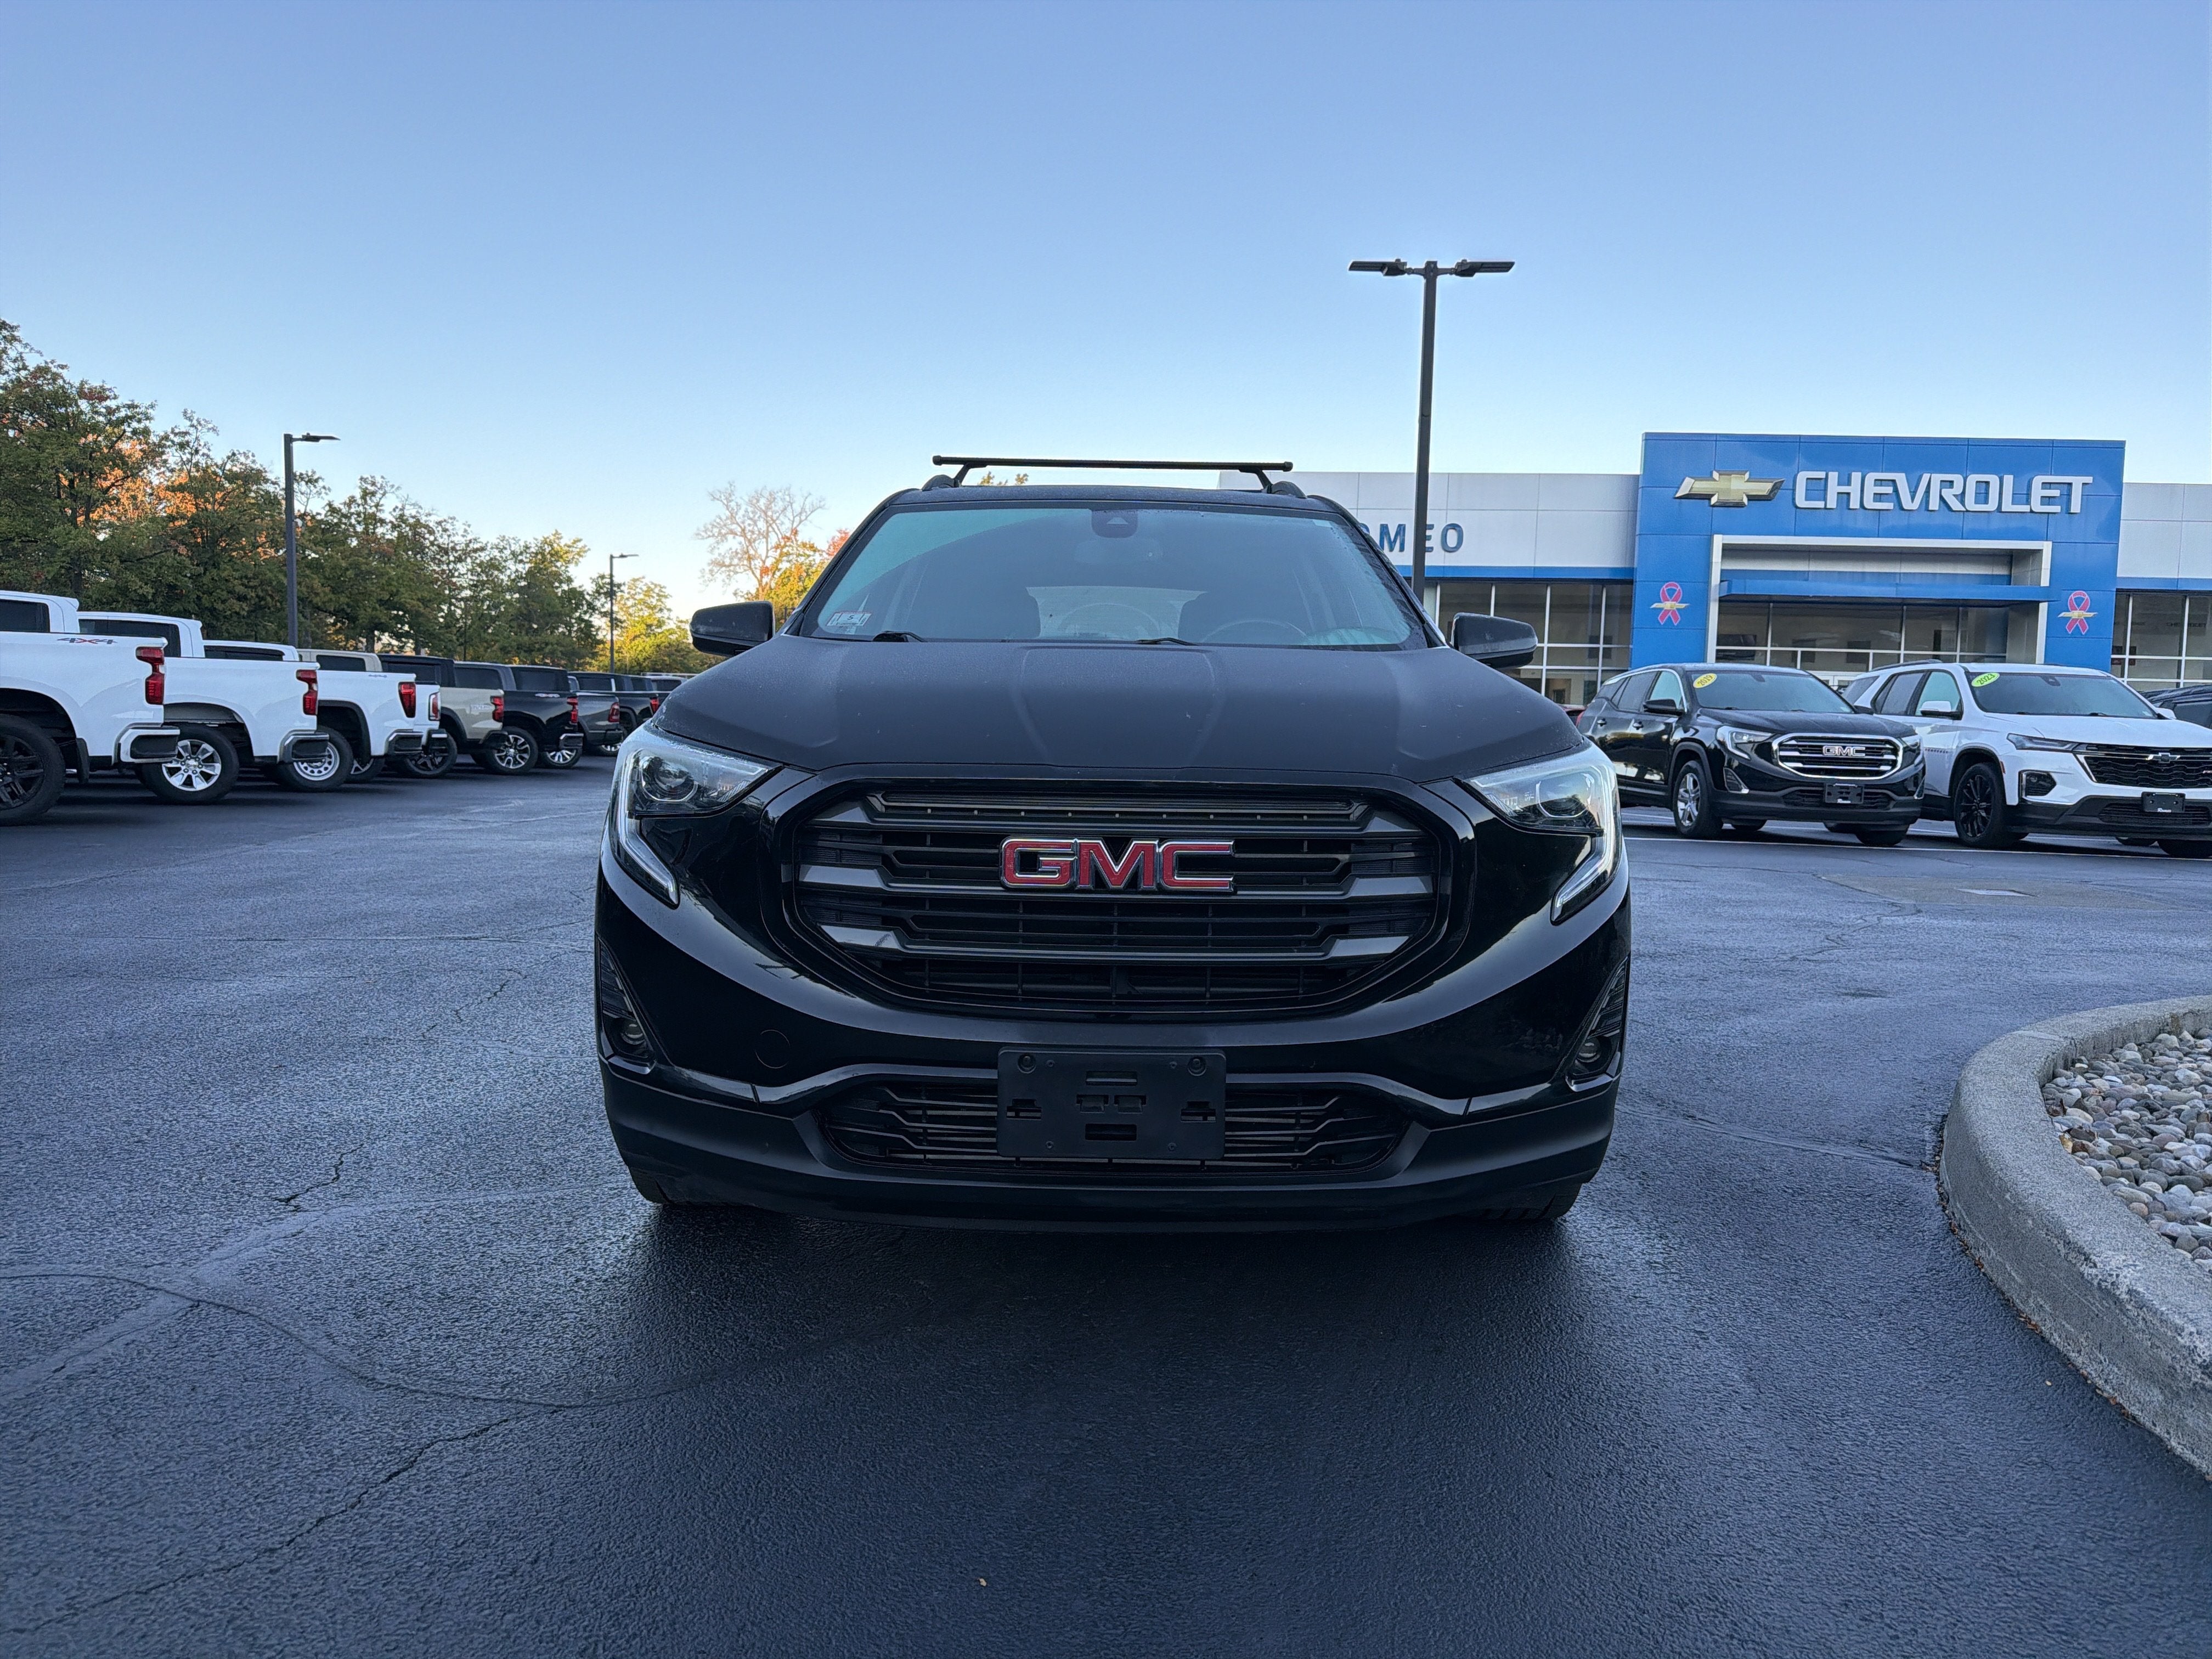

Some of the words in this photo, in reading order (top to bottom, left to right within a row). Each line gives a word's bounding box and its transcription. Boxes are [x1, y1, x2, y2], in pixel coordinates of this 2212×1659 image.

[1795, 471, 2094, 514] CHEVROLET
[1358, 522, 1464, 553] MEO
[1697, 675, 1713, 686] 2019
[1976, 673, 1996, 685] 2023
[1822, 745, 1866, 757] GMC
[1000, 836, 1237, 893] GMC
